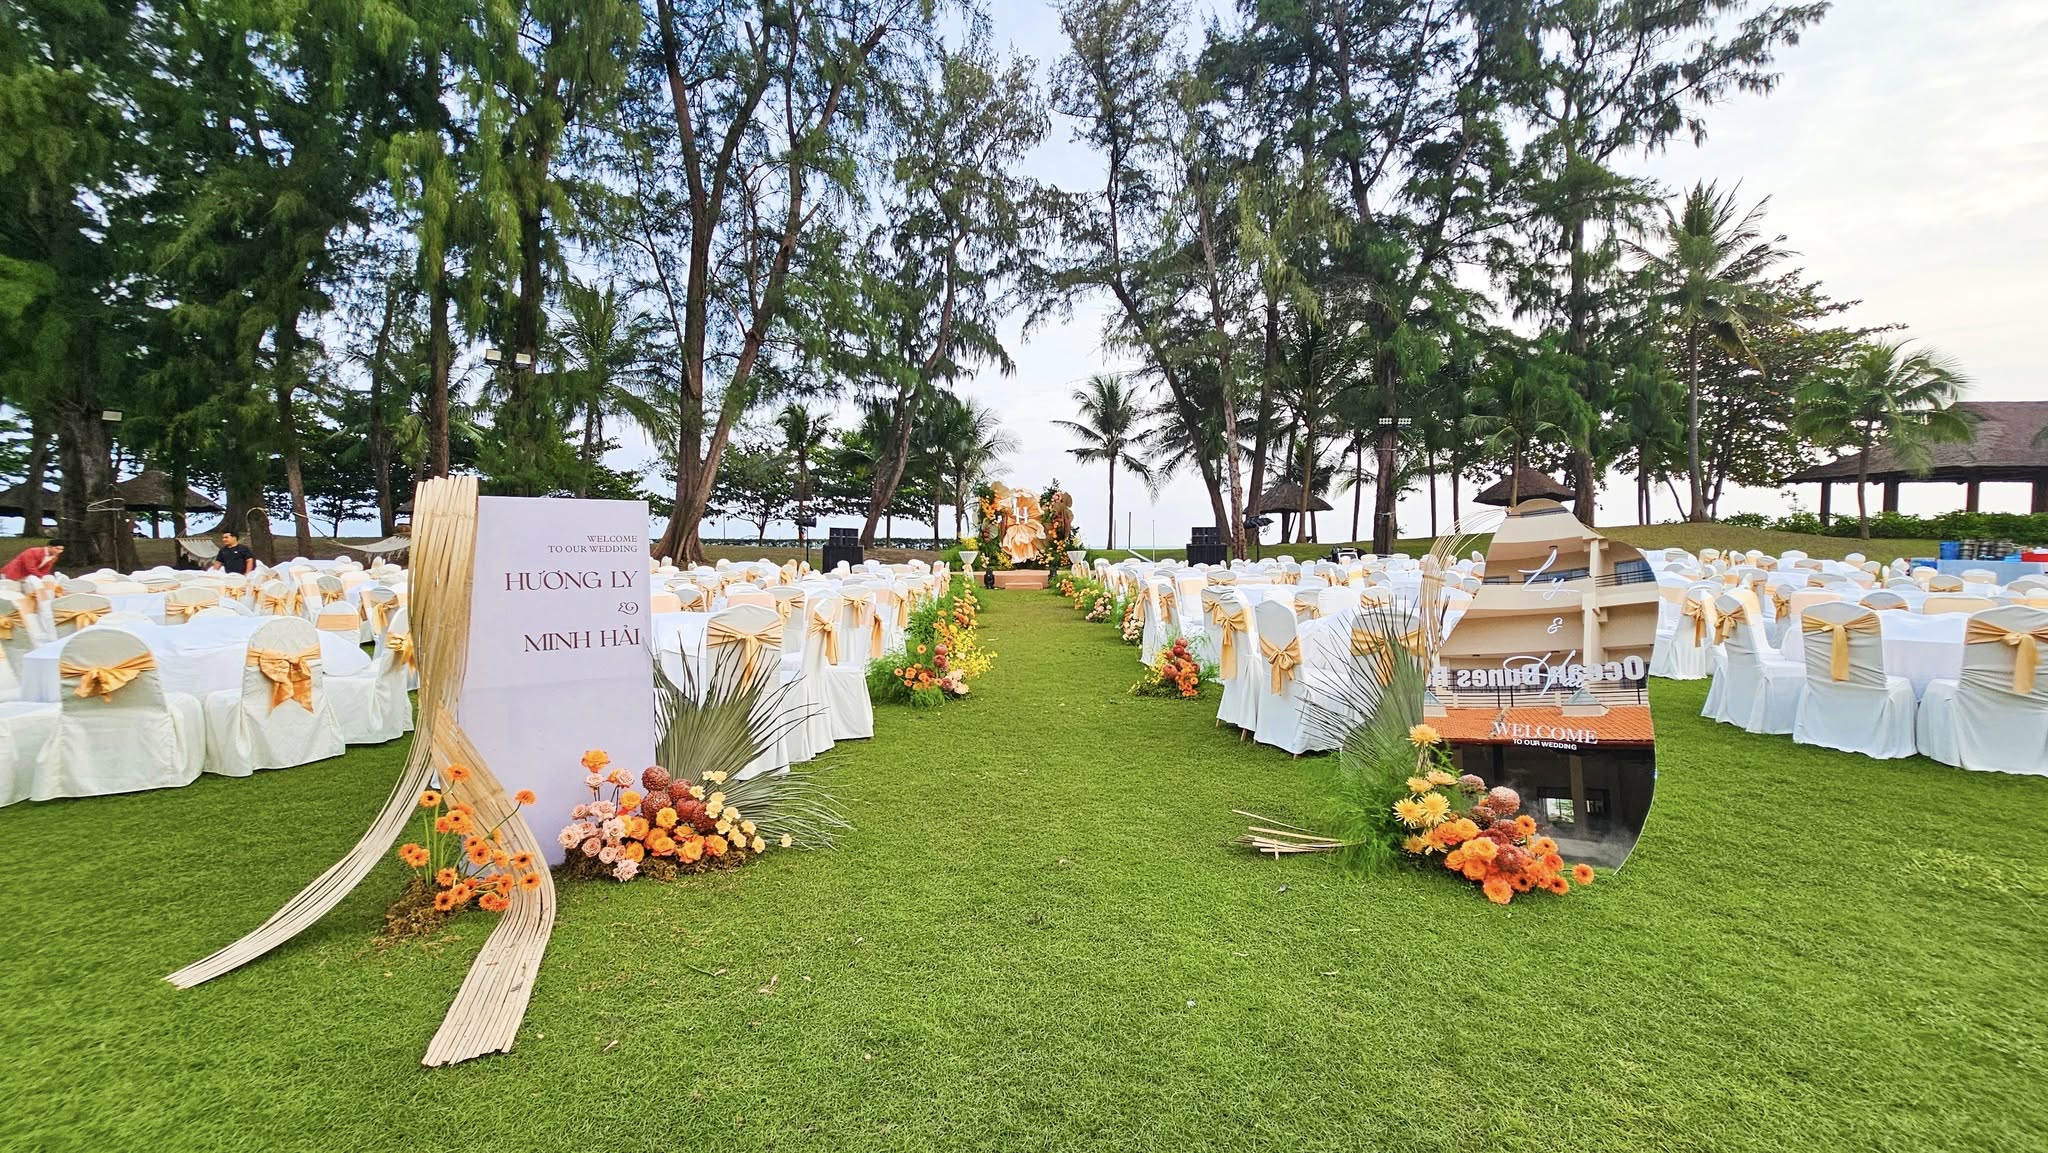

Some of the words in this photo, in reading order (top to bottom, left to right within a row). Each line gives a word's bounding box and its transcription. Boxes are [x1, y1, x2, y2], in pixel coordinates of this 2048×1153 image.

[548, 545, 563, 553] TO
[565, 545, 587, 553] OUR
[589, 545, 638, 553] WEDDING
[586, 535, 638, 543] WELCOME
[505, 570, 602, 591] HƯƠNG
[610, 570, 638, 588] LY
[1517, 549, 1580, 600] Ly
[524, 631, 591, 652] MINH
[600, 624, 640, 648] HẢI
[1494, 721, 1598, 745] WELCOME
[1541, 741, 1577, 750] WEDDING
